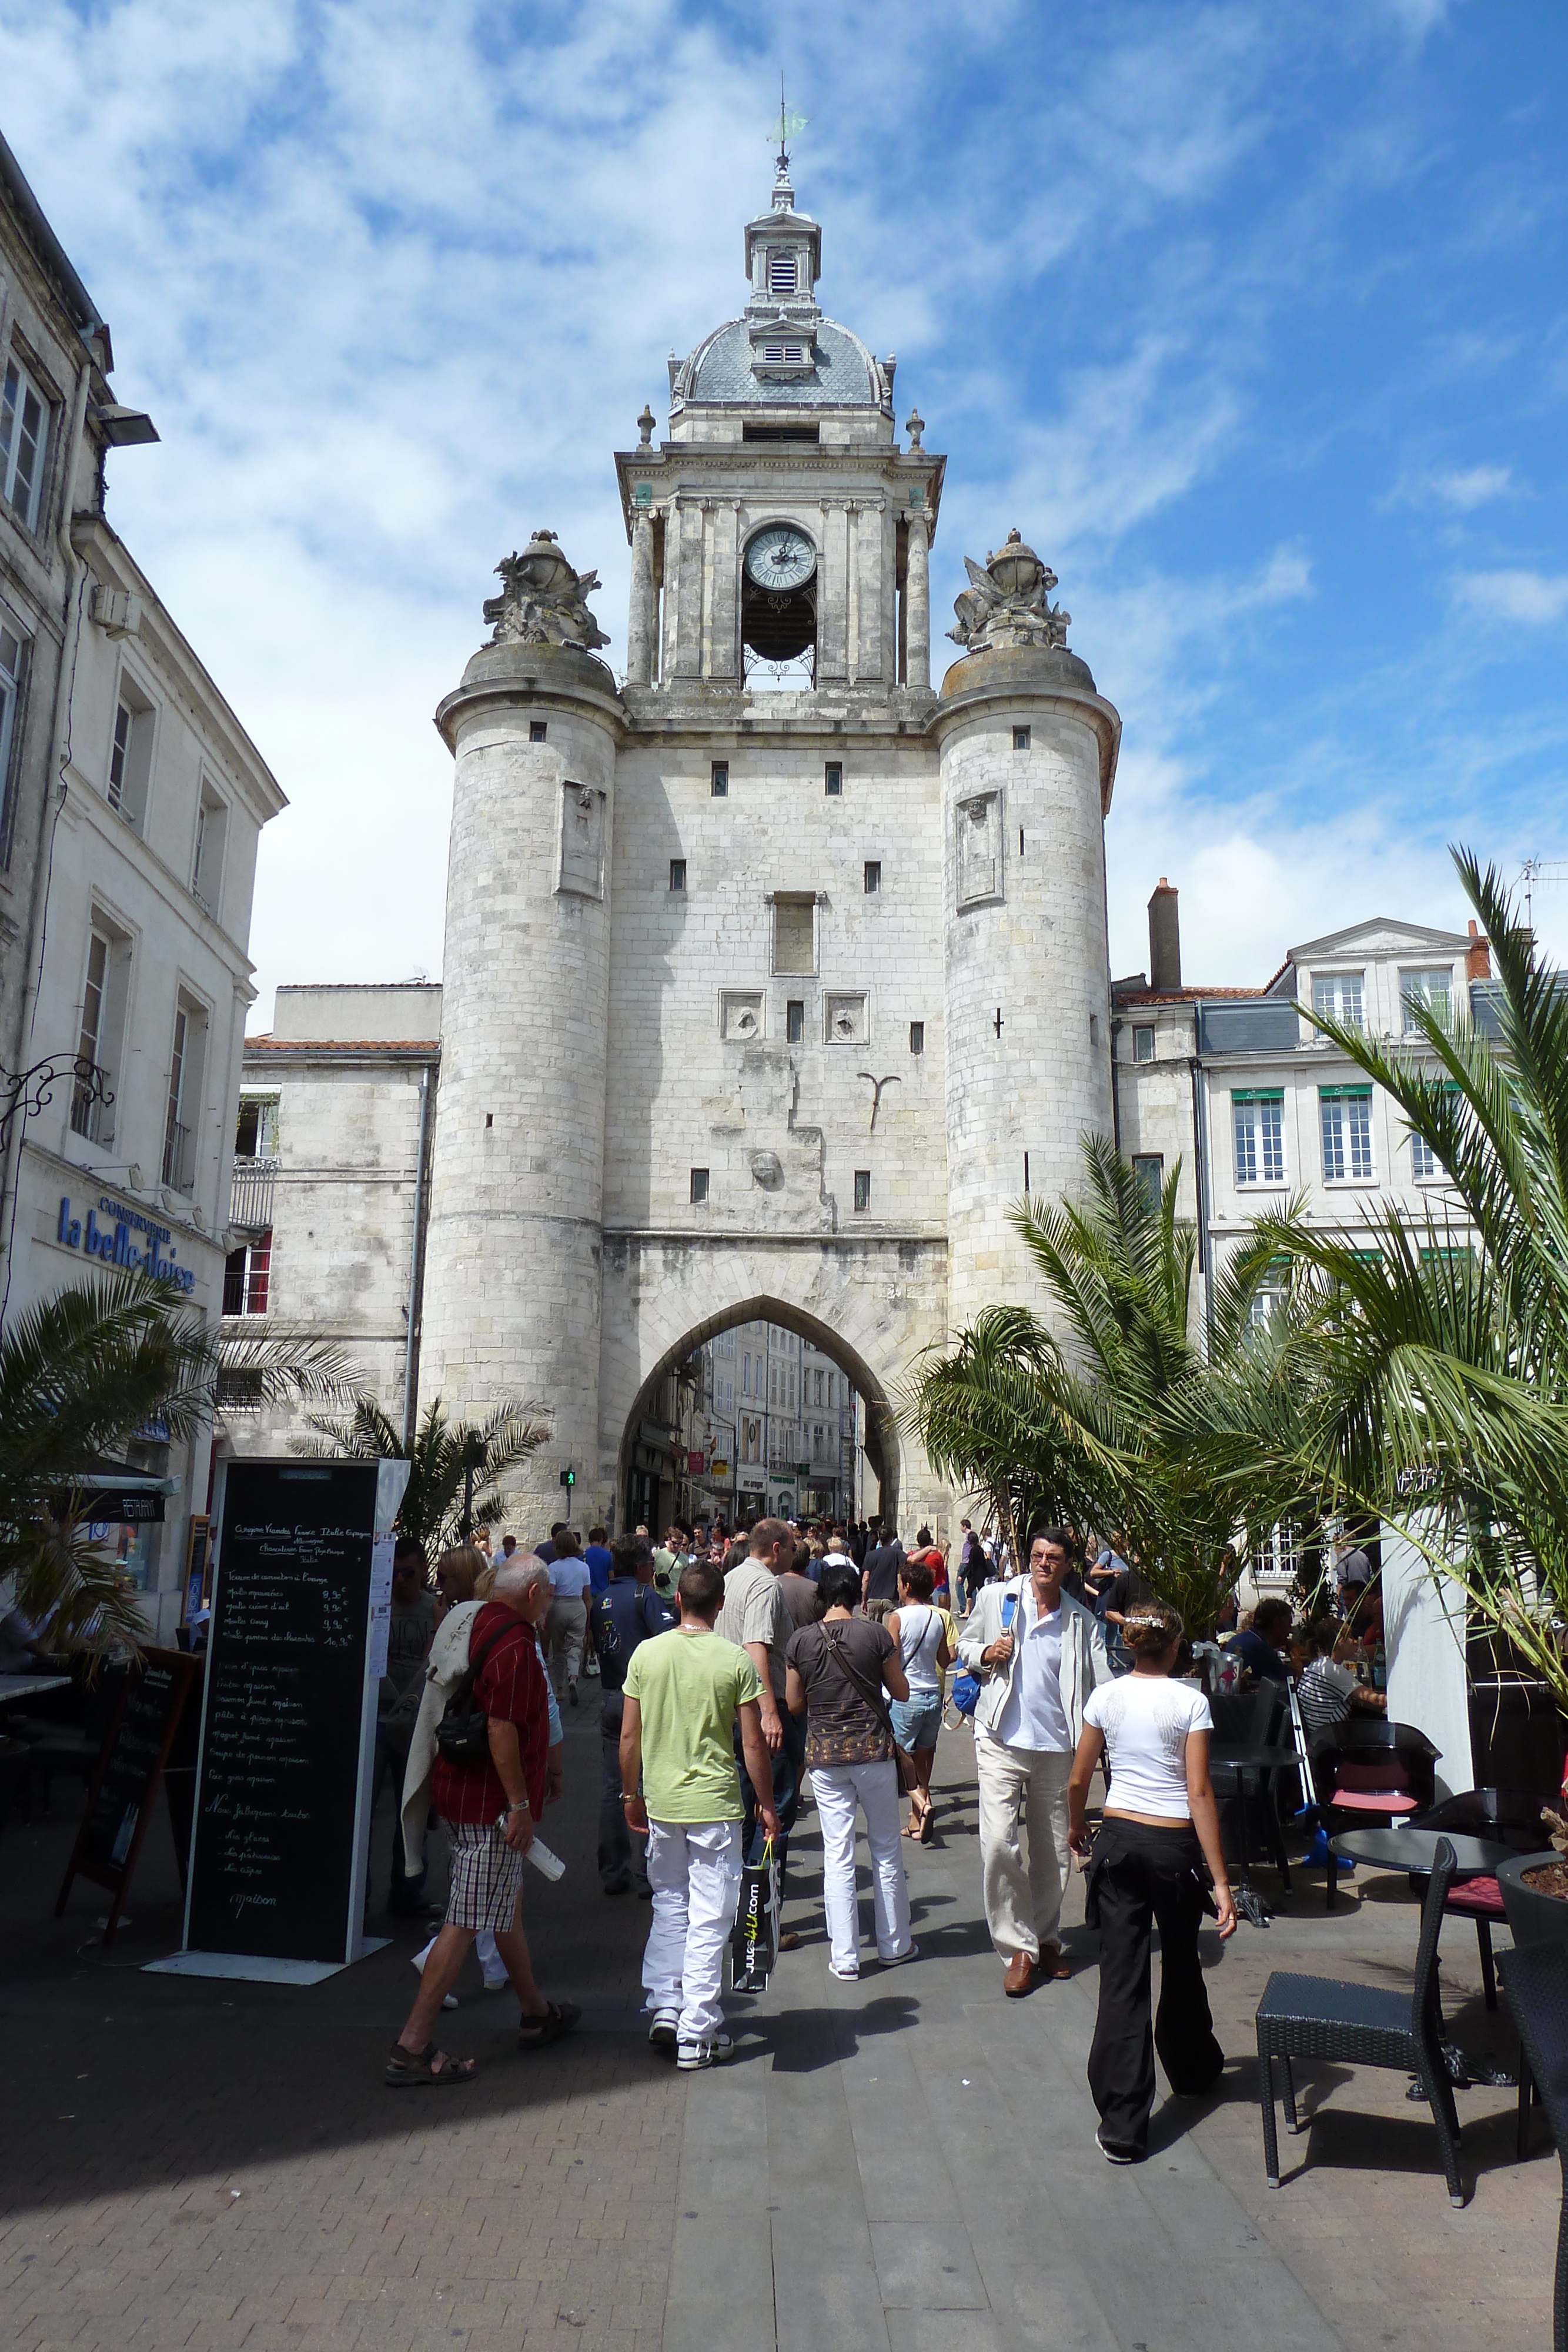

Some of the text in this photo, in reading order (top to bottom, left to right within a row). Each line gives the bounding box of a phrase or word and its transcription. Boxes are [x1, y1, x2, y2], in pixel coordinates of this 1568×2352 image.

[58, 1197, 81, 1248] la
[99, 1197, 171, 1244] CONSERVERIE
[251, 1572, 259, 1581] de
